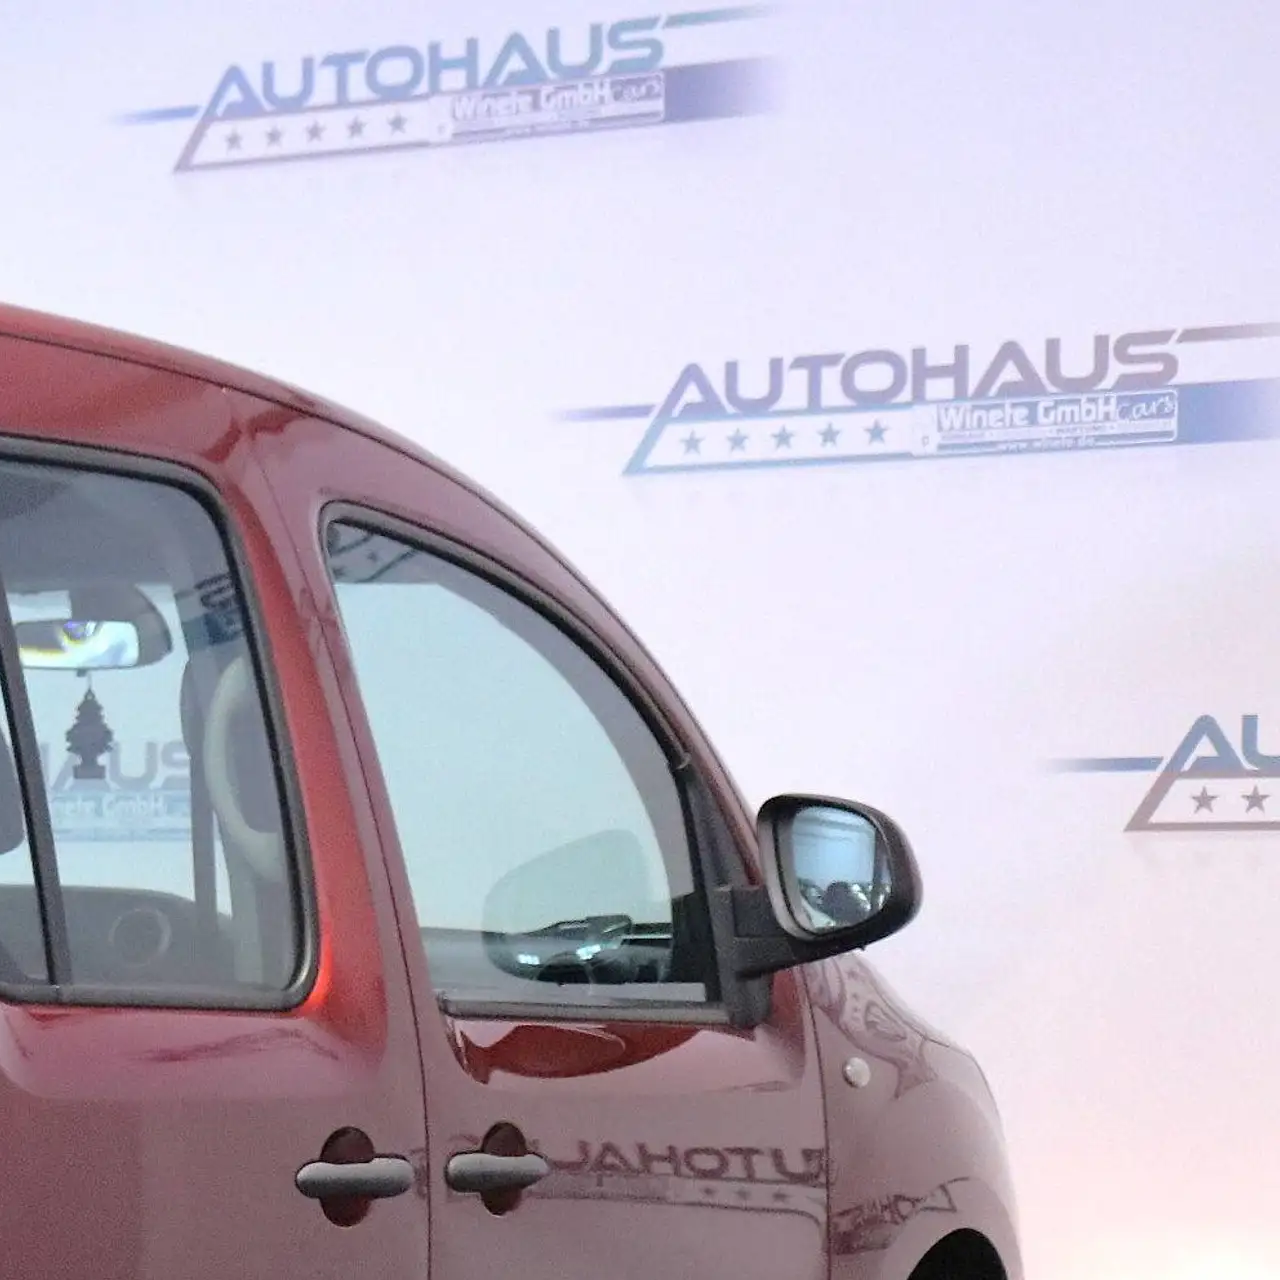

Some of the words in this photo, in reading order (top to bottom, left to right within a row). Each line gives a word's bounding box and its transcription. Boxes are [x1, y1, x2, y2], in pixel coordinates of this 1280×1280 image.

[192, 15, 666, 130] AUTOHAUS
[540, 80, 611, 110] GmbH
[645, 330, 1181, 428] AUTOHAUS
[1037, 391, 1117, 423] GmbH
